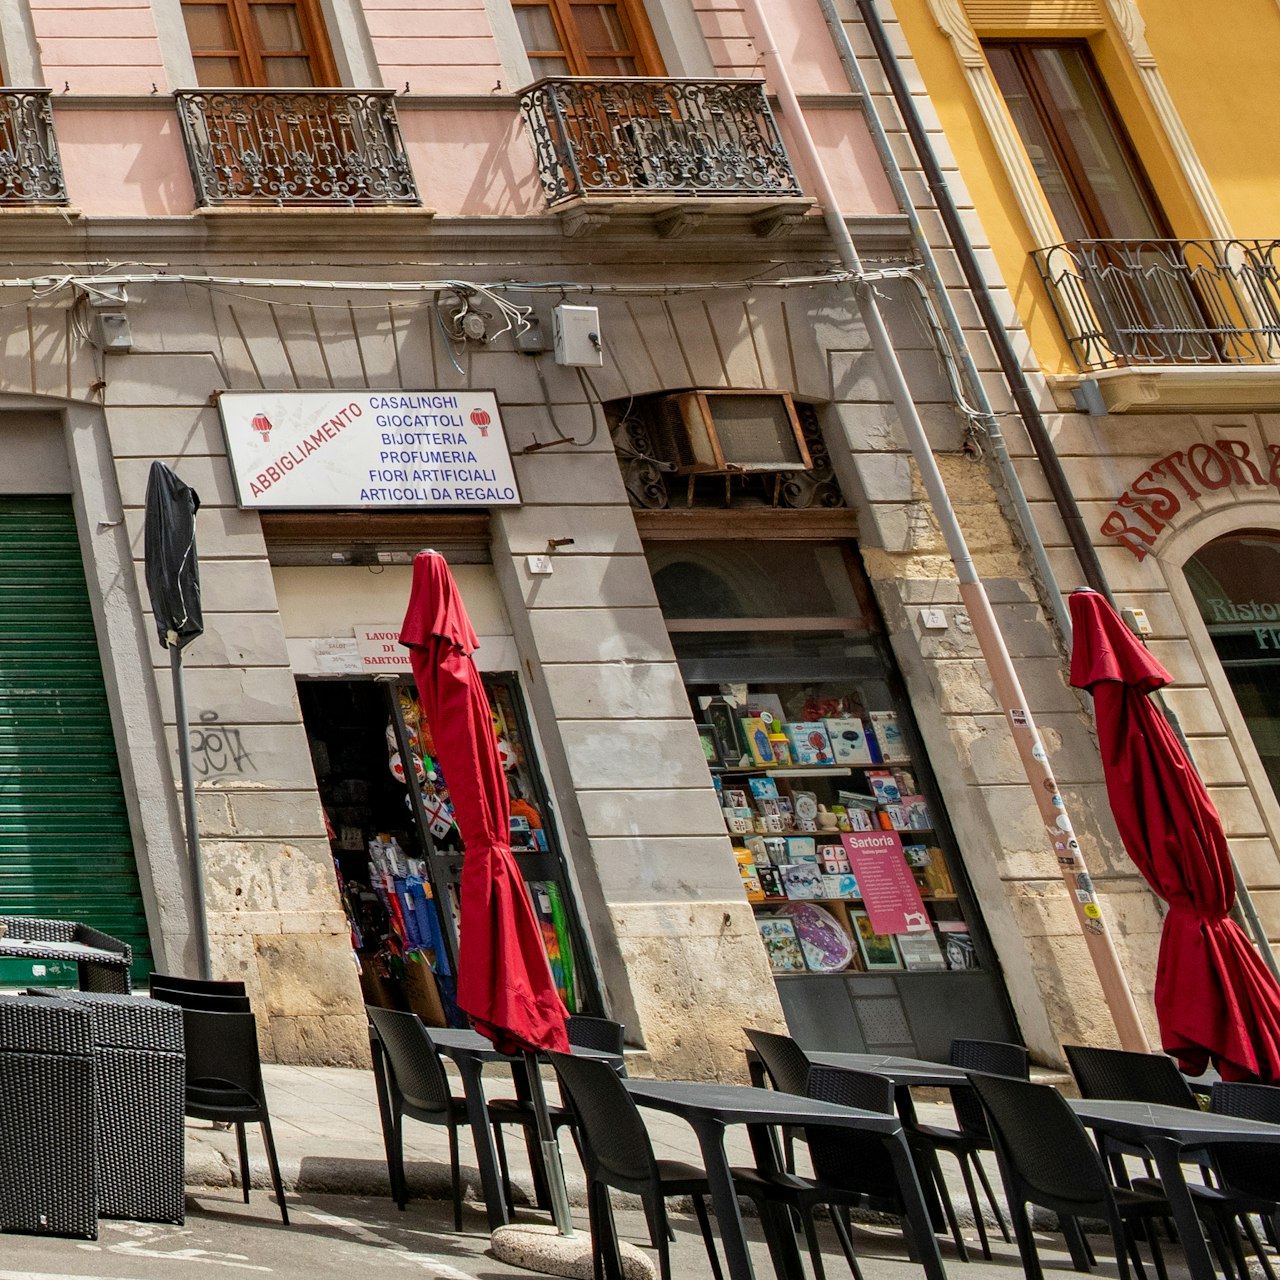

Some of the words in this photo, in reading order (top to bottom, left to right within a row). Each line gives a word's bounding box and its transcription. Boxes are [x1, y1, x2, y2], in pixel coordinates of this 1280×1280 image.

[369, 396, 458, 410] CASALINGHI
[375, 414, 464, 428] GIOCATTOLI
[381, 432, 468, 446] BIJOTTERIA
[248, 402, 363, 498] ABBIGLIAMENTO
[380, 451, 478, 464] PROFUMERIA
[369, 469, 409, 483] FIORI
[412, 469, 497, 483] ARTIFICIALI
[360, 488, 428, 502] ARTICOLI
[432, 488, 453, 501] DA
[455, 487, 515, 501] REGALO
[366, 632, 401, 641] LAVOR
[1252, 626, 1280, 650] Fl
[382, 644, 395, 652] DI
[364, 656, 412, 664] SARTOR
[849, 834, 895, 848] Sartoria
